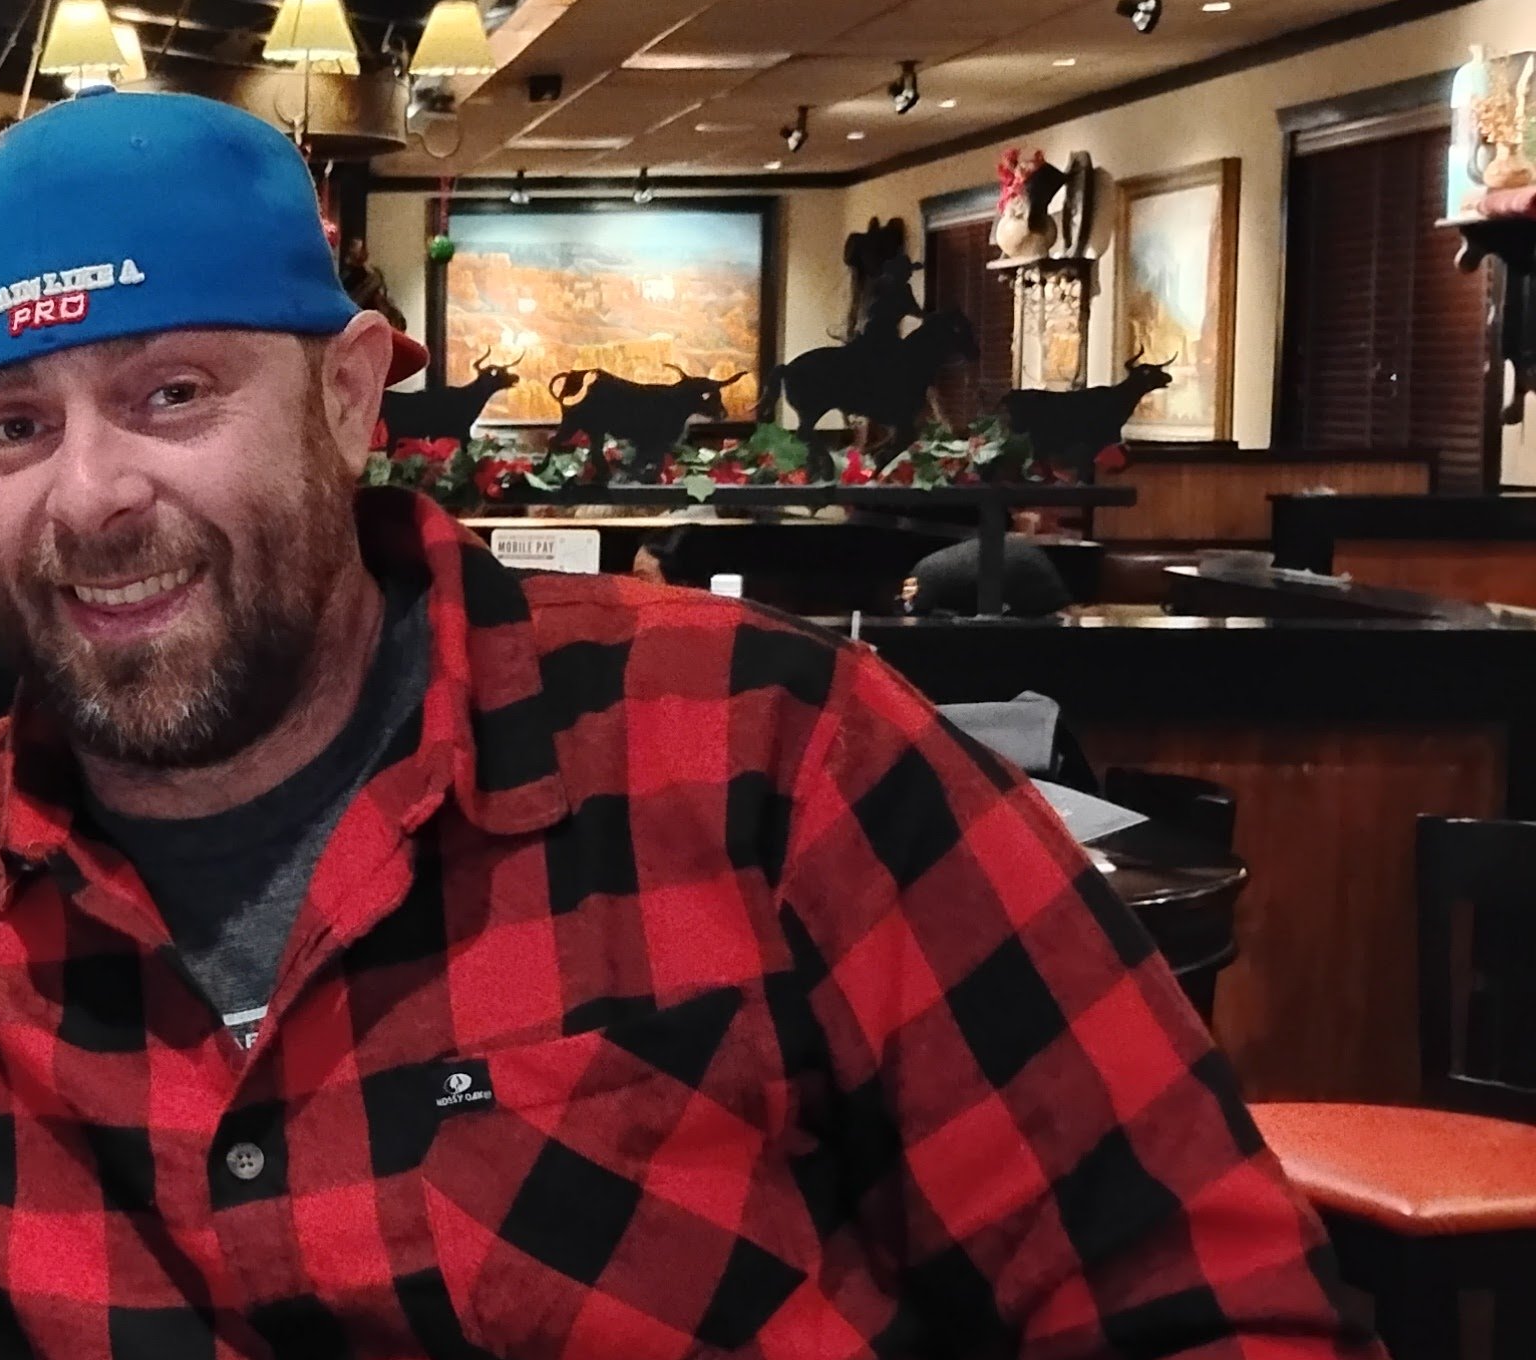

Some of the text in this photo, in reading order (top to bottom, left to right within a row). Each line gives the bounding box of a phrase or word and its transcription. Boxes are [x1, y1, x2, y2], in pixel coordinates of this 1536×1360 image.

[42, 263, 115, 296] LIKE
[11, 291, 86, 331] PRO
[497, 541, 554, 553] MOBILE PAY
